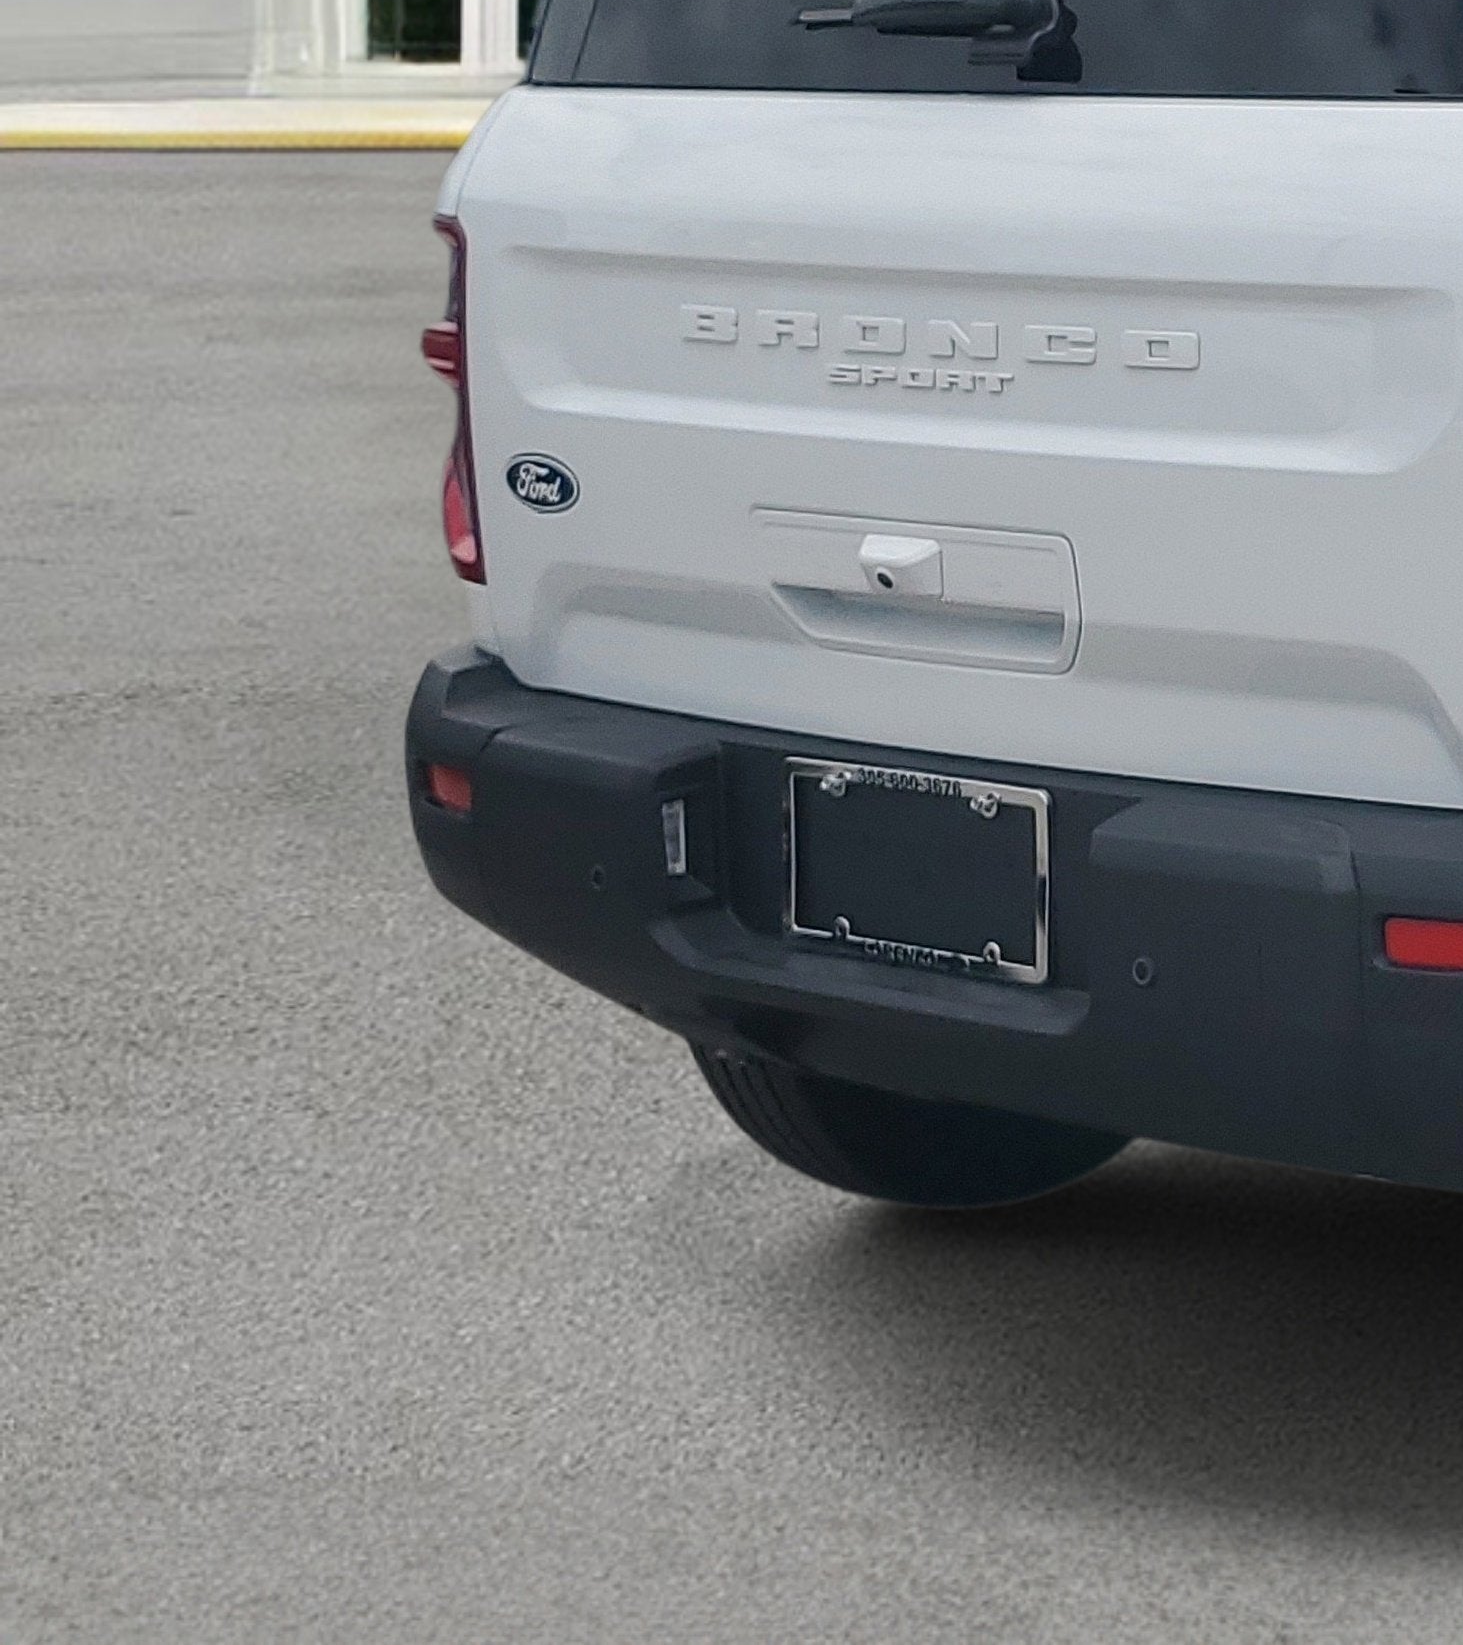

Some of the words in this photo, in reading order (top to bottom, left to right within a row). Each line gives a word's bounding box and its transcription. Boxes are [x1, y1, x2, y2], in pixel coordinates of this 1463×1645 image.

[681, 303, 1201, 370] BRONCO
[827, 363, 1014, 393] SPORT
[516, 462, 562, 503] Ford
